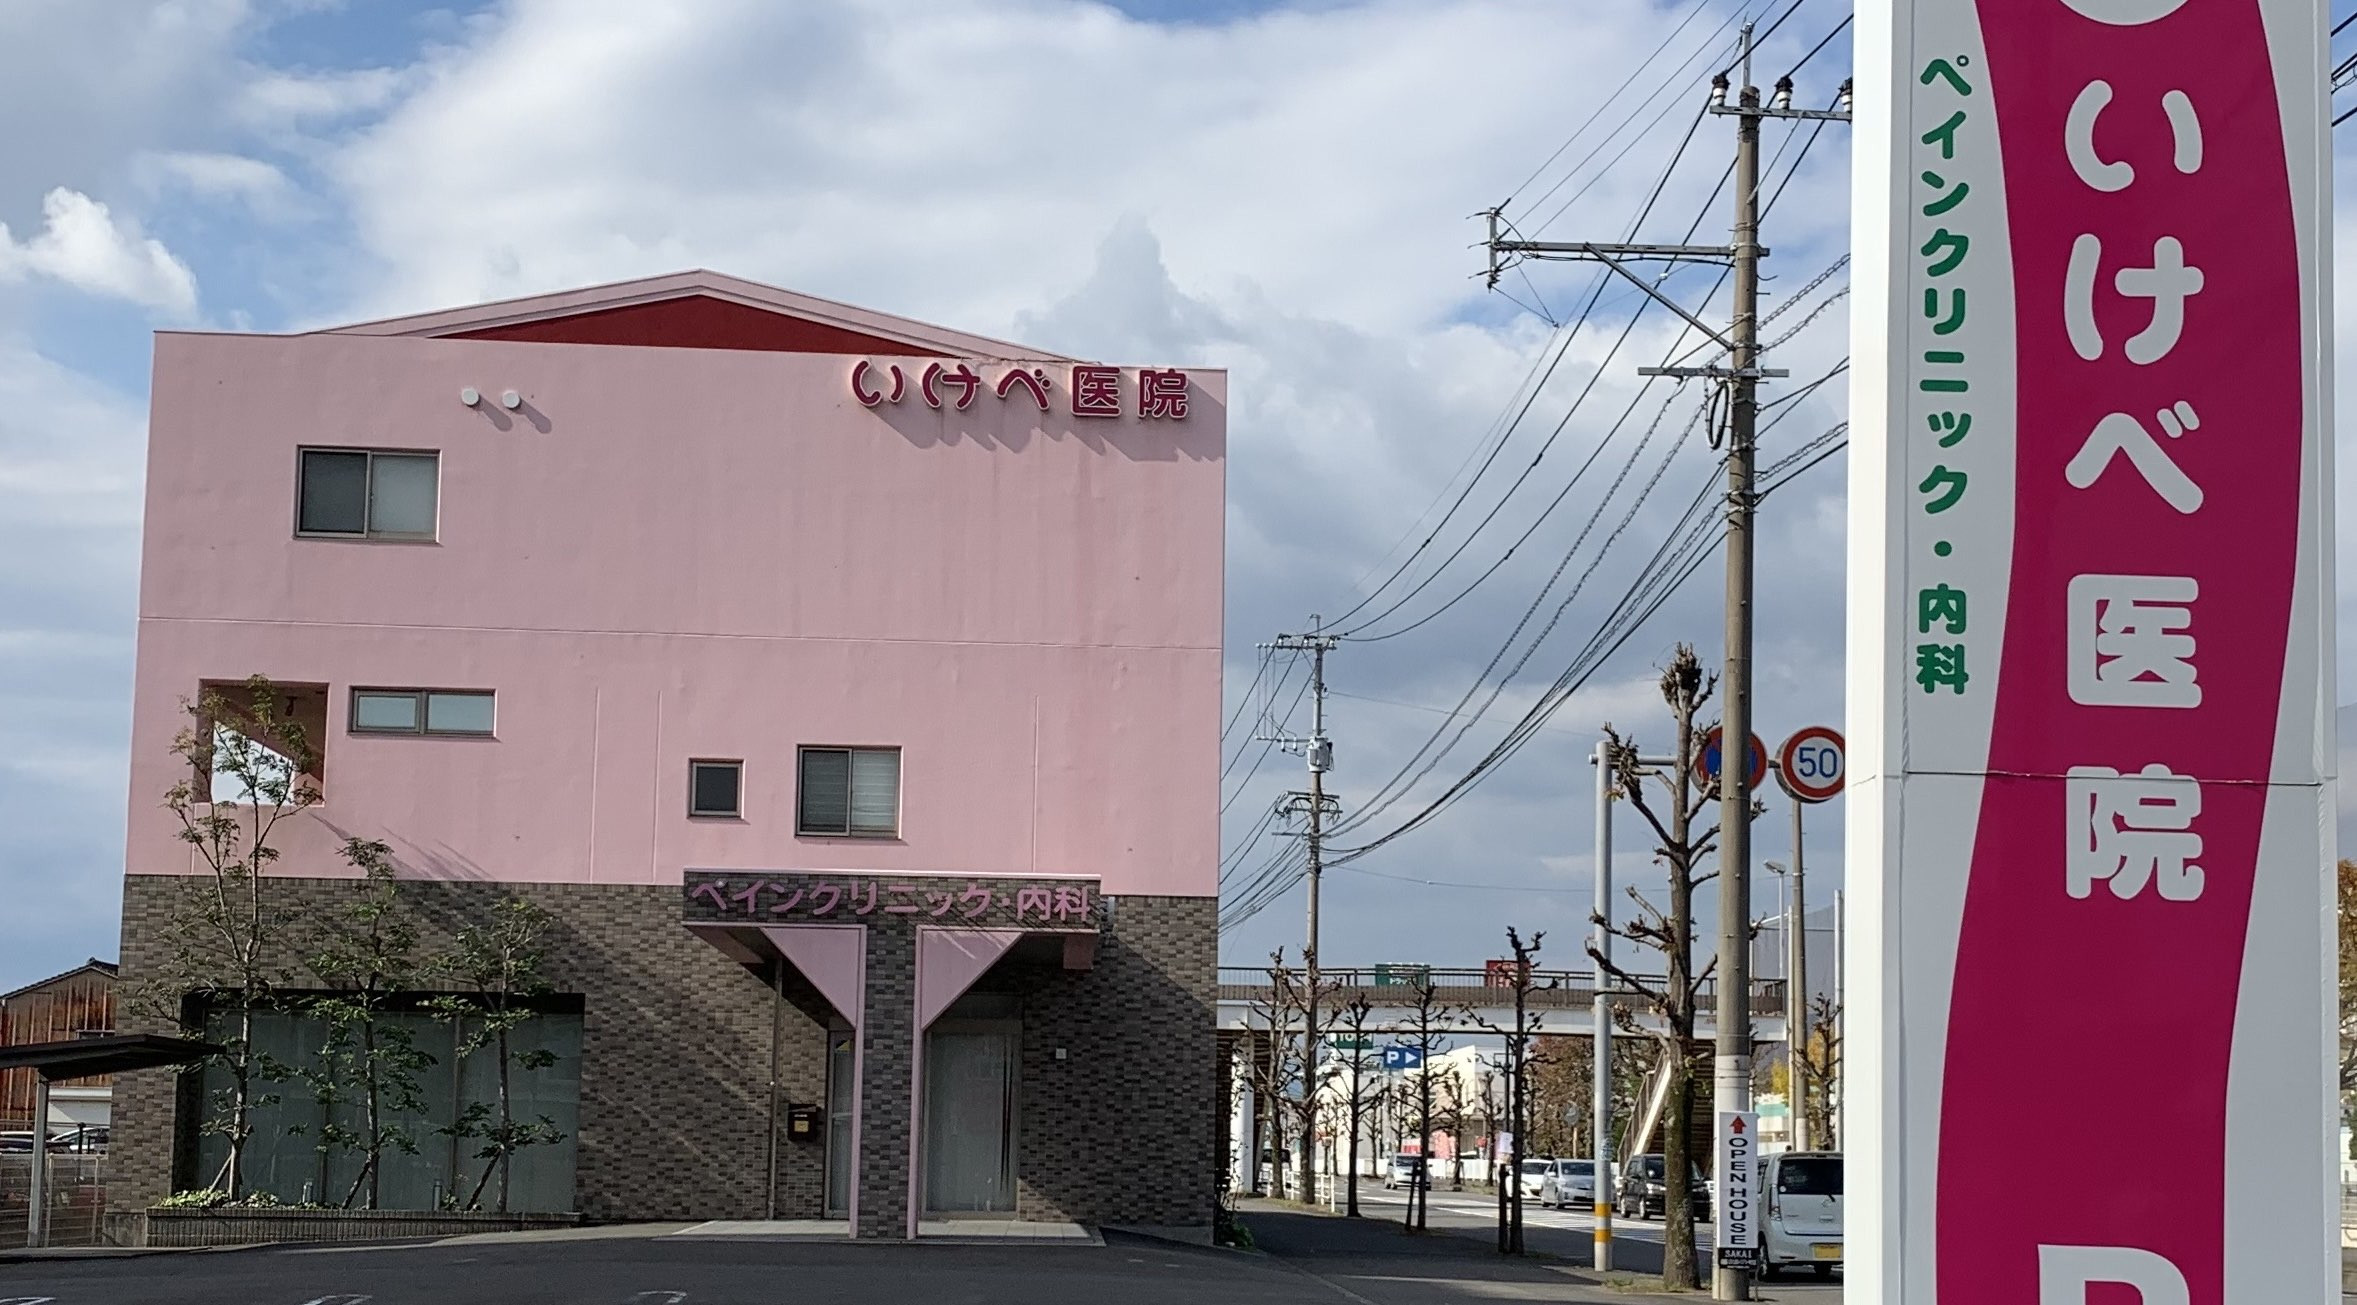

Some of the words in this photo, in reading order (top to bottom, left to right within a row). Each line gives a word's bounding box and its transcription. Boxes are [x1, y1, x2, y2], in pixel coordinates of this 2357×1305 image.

[852, 359, 1189, 419] いけべ医院
[1916, 54, 1972, 695] ペインクリニック・内科
[2063, 79, 2206, 902] いけべ医院
[1798, 747, 1838, 778] 50
[690, 879, 1091, 922] ペインクリニック・内科
[1386, 1051, 1399, 1064] P
[1728, 1137, 1748, 1182] OPEN
[1728, 1188, 1748, 1245] HOUSE
[1724, 1249, 1753, 1259] SAKAI
